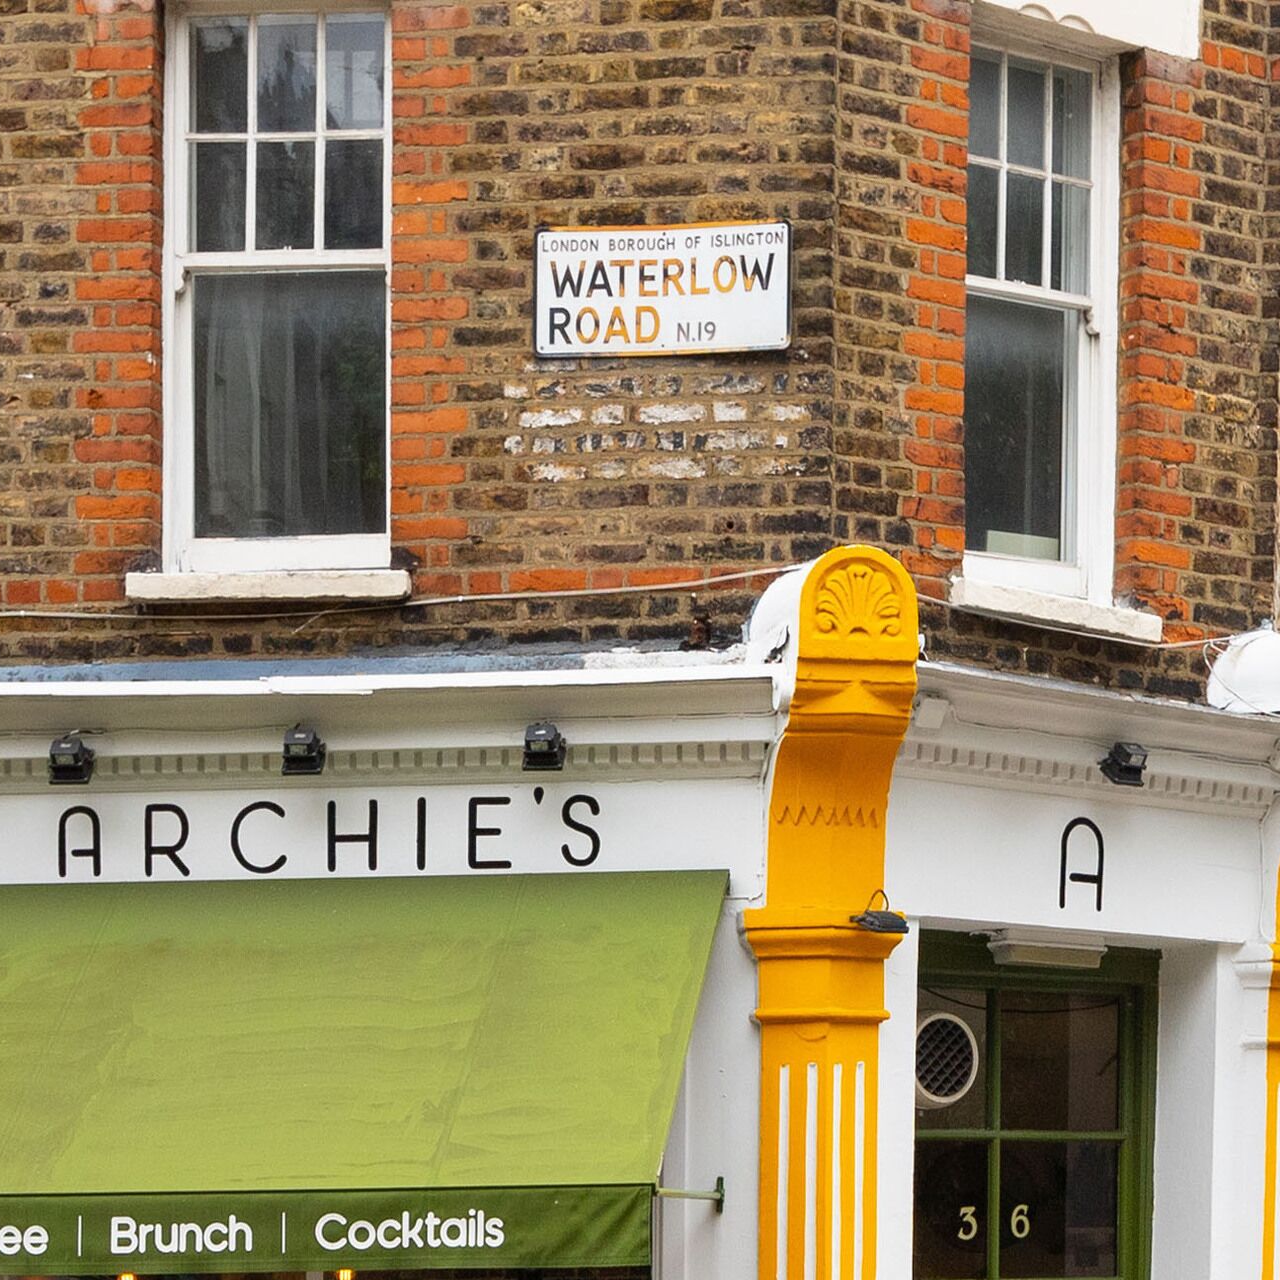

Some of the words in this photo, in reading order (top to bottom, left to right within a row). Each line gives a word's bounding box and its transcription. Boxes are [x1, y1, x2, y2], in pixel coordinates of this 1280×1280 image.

[542, 239, 599, 252] LONDON
[609, 237, 675, 251] BOROUGH
[685, 235, 701, 249] OF
[710, 231, 785, 248] ISLINGTON
[550, 253, 775, 298] WATERLOW
[549, 306, 660, 345] ROAD
[676, 321, 717, 343] N.19
[58, 787, 601, 877] ARCHIE'S
[1059, 817, 1105, 911] A
[109, 1214, 253, 1254] Brunch
[314, 1209, 505, 1251] Cocktails
